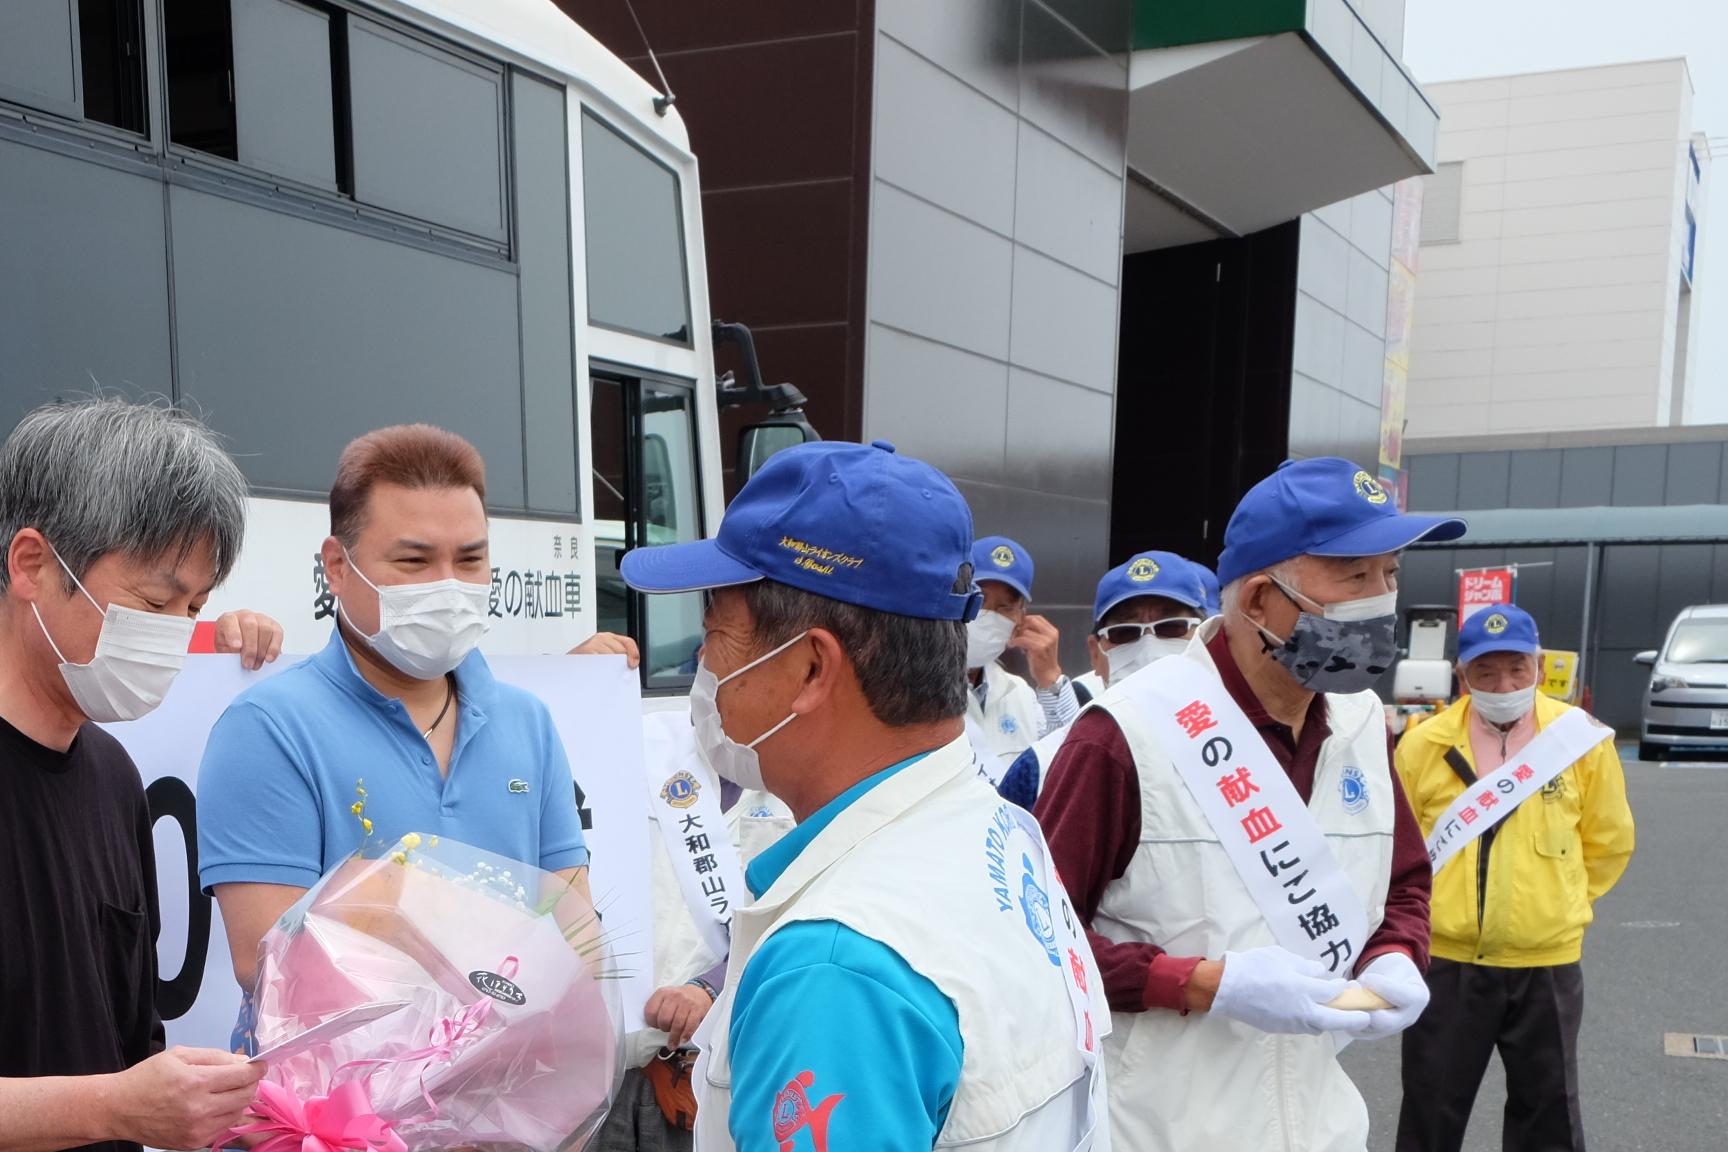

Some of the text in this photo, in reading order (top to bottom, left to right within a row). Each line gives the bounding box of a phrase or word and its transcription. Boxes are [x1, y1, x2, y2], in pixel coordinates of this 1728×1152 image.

[553, 535, 579, 560] 奈良
[678, 813, 731, 962] 大和郡山ライ
[985, 827, 1014, 912] YAMATO
